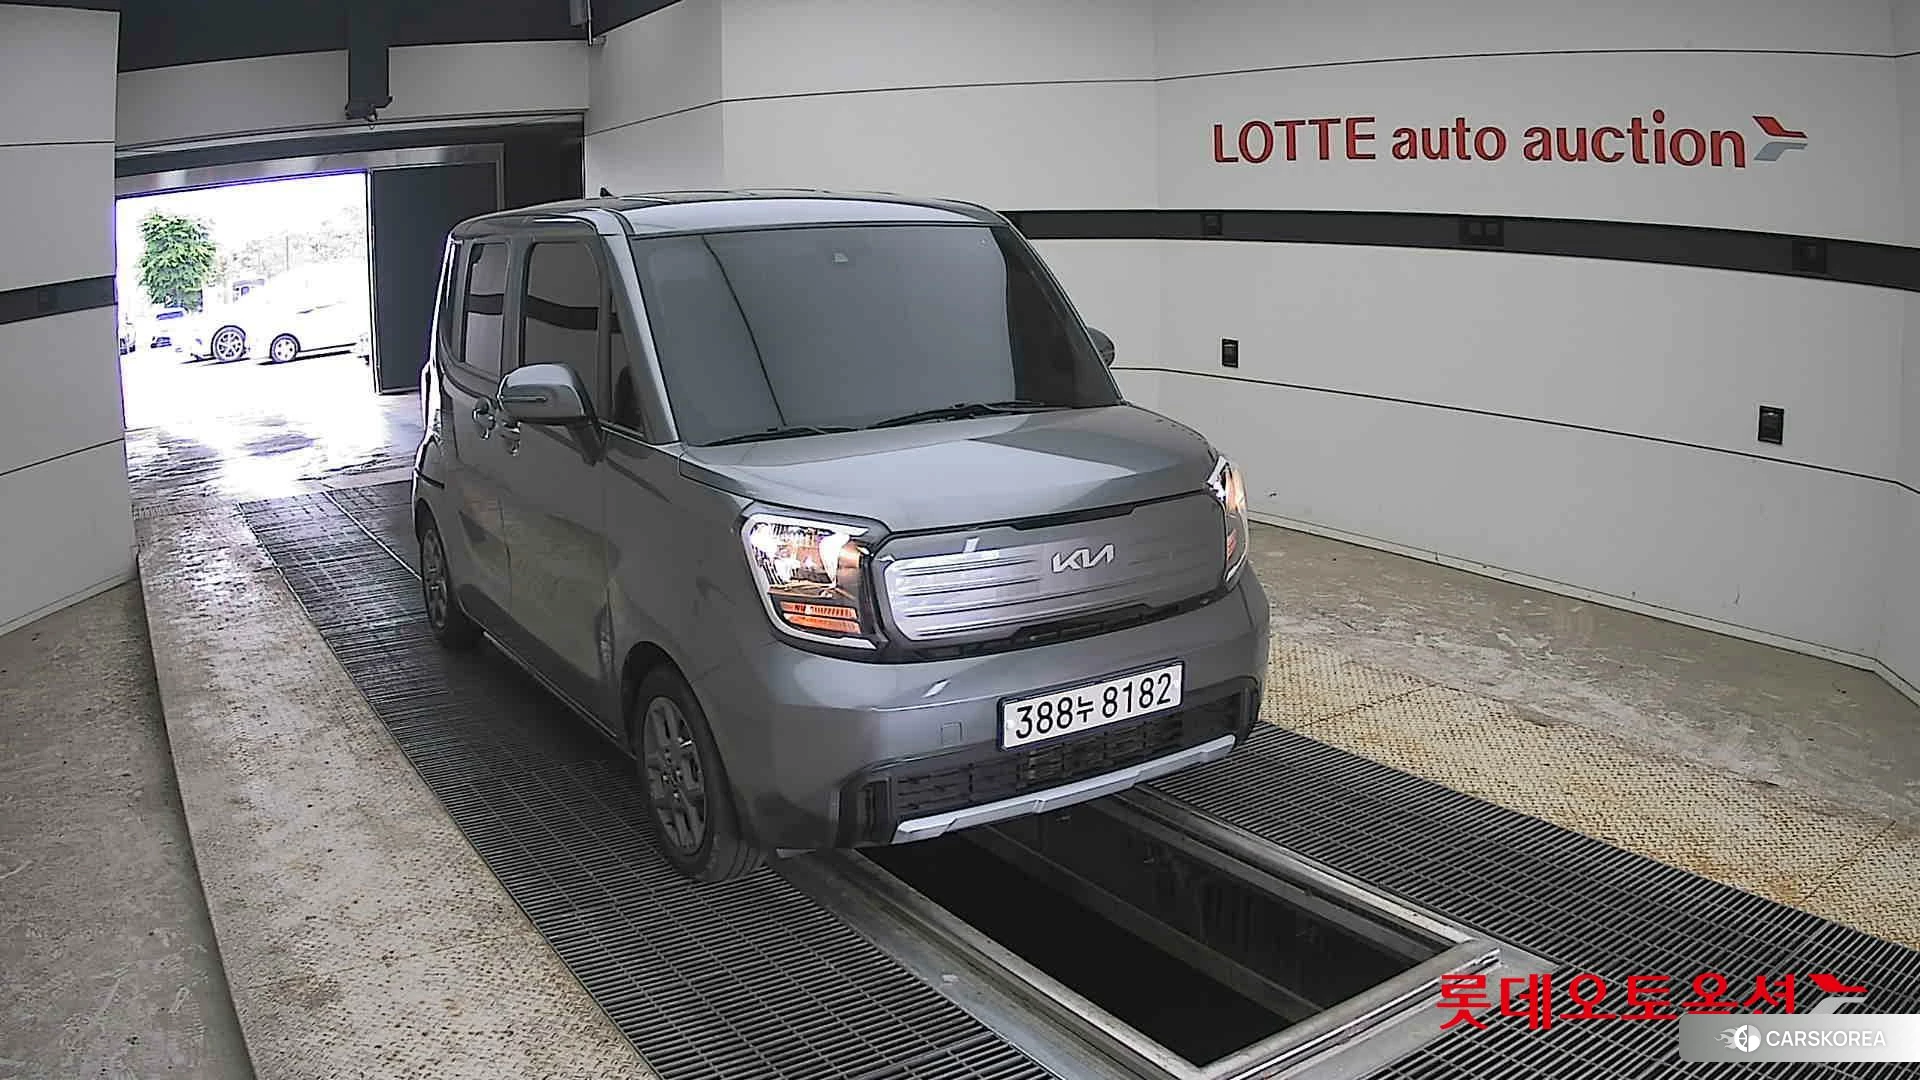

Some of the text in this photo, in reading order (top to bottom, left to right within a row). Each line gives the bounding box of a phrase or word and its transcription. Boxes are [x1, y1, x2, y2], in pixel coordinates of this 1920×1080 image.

[1213, 109, 1747, 168] LOTTE auto auction
[1051, 543, 1115, 574] KIA
